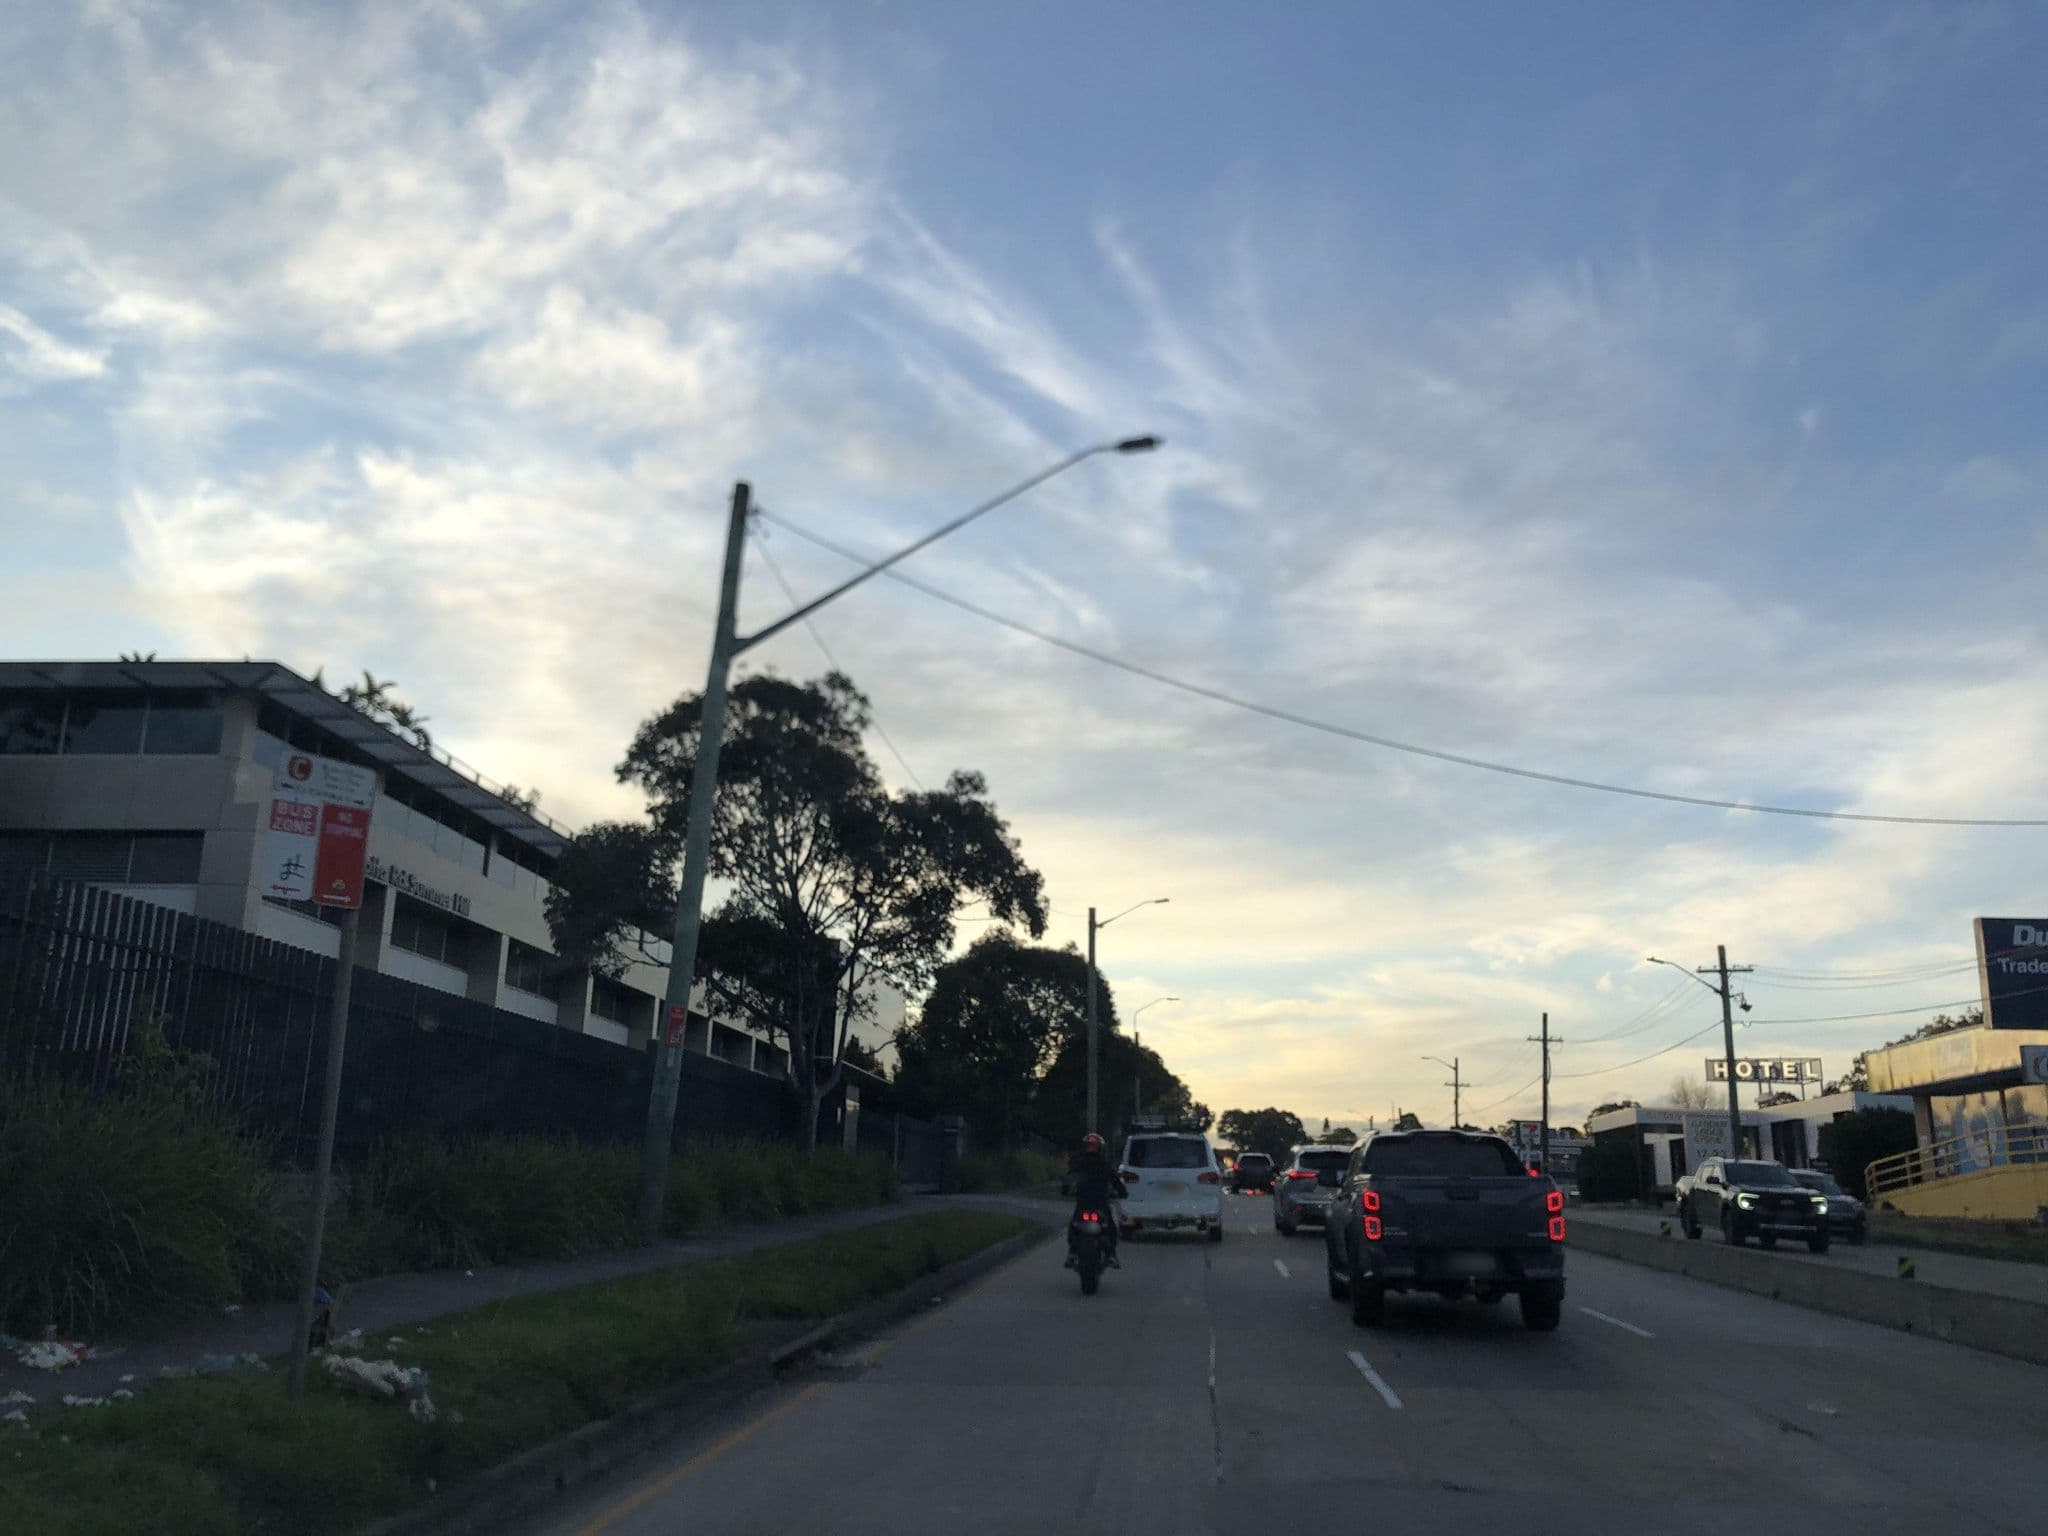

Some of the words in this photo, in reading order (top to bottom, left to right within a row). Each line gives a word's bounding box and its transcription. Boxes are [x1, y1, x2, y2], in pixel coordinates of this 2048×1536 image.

[276, 801, 313, 819] BUS
[271, 816, 313, 835] ZONE
[1713, 1061, 1819, 1080] HOTEL
